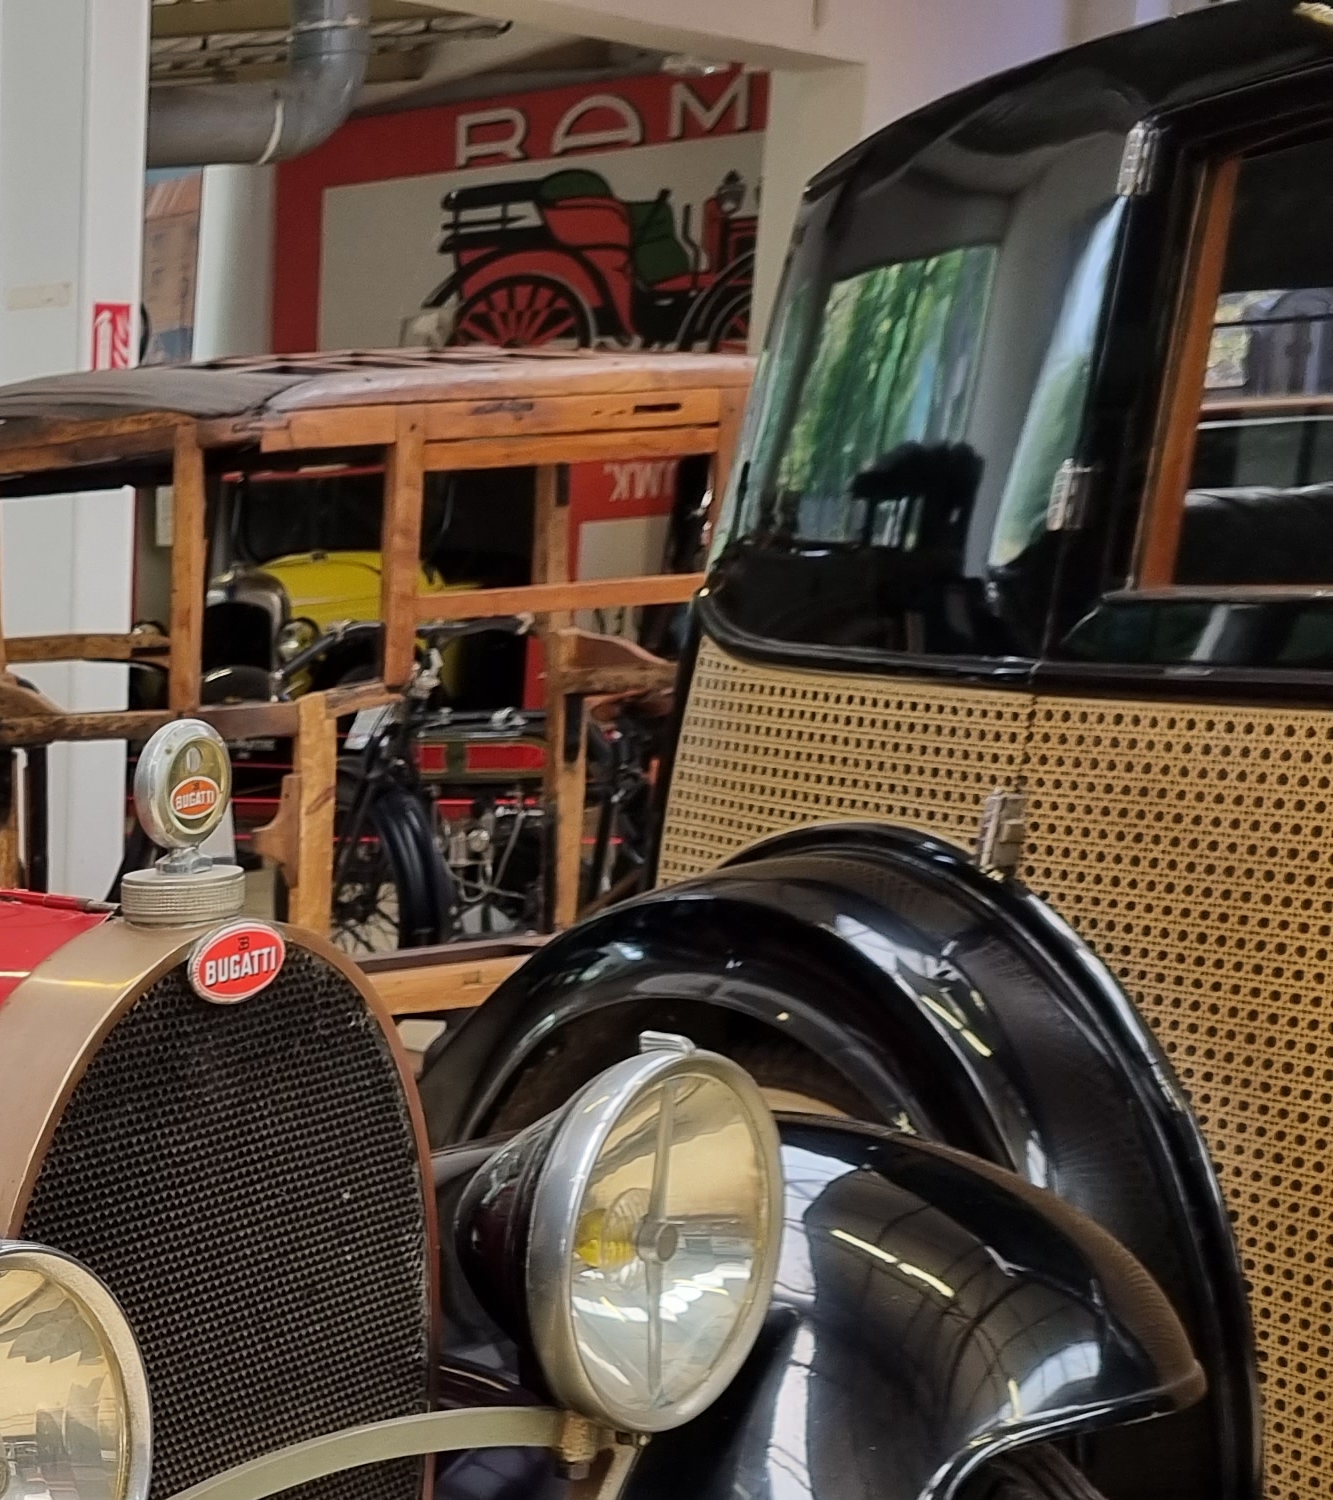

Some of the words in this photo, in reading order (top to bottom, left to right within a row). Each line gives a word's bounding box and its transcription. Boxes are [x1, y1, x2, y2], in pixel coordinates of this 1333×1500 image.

[455, 73, 752, 168] RAM
[175, 790, 215, 811] BUGATTI
[204, 946, 277, 987] BUGATTI
